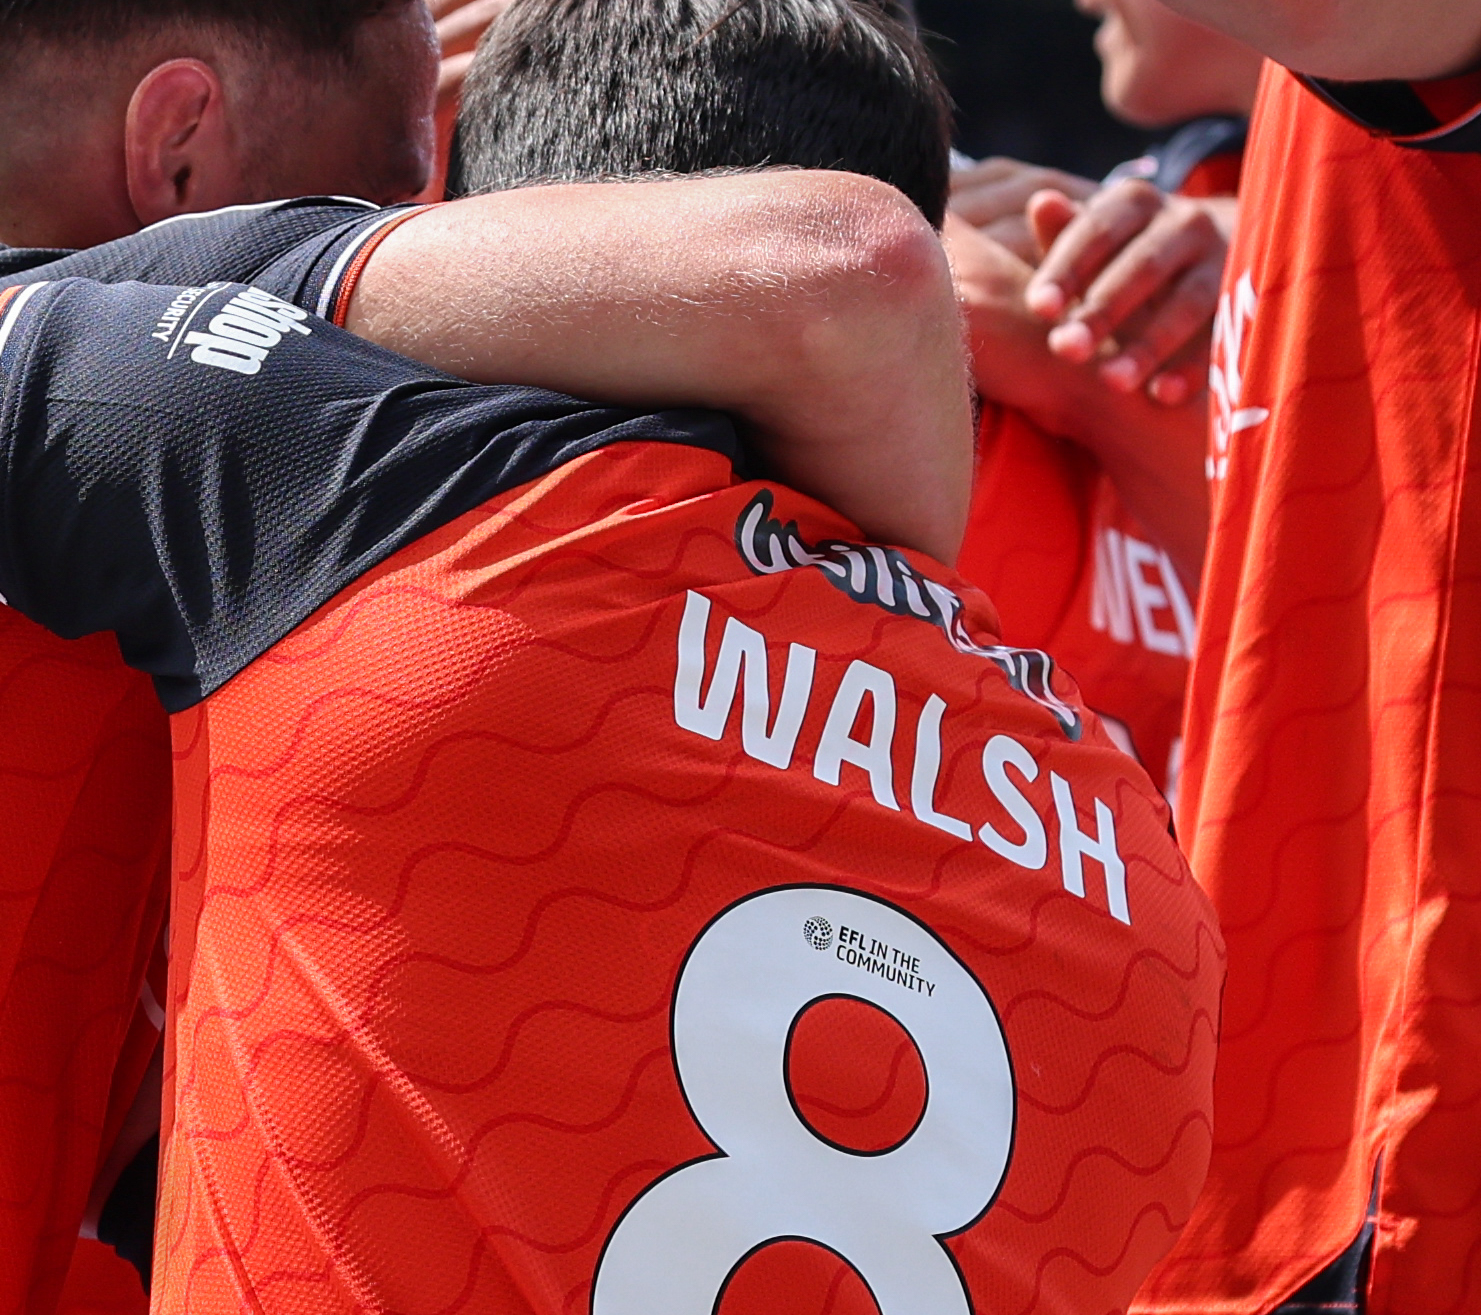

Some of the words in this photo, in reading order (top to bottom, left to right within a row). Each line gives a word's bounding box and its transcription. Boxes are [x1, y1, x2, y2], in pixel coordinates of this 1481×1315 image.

[674, 588, 1132, 926] WALSH
[836, 944, 936, 997] COMMUNITY
[839, 925, 867, 951] EFL
[869, 938, 889, 960] IN
[892, 947, 921, 974] THE
